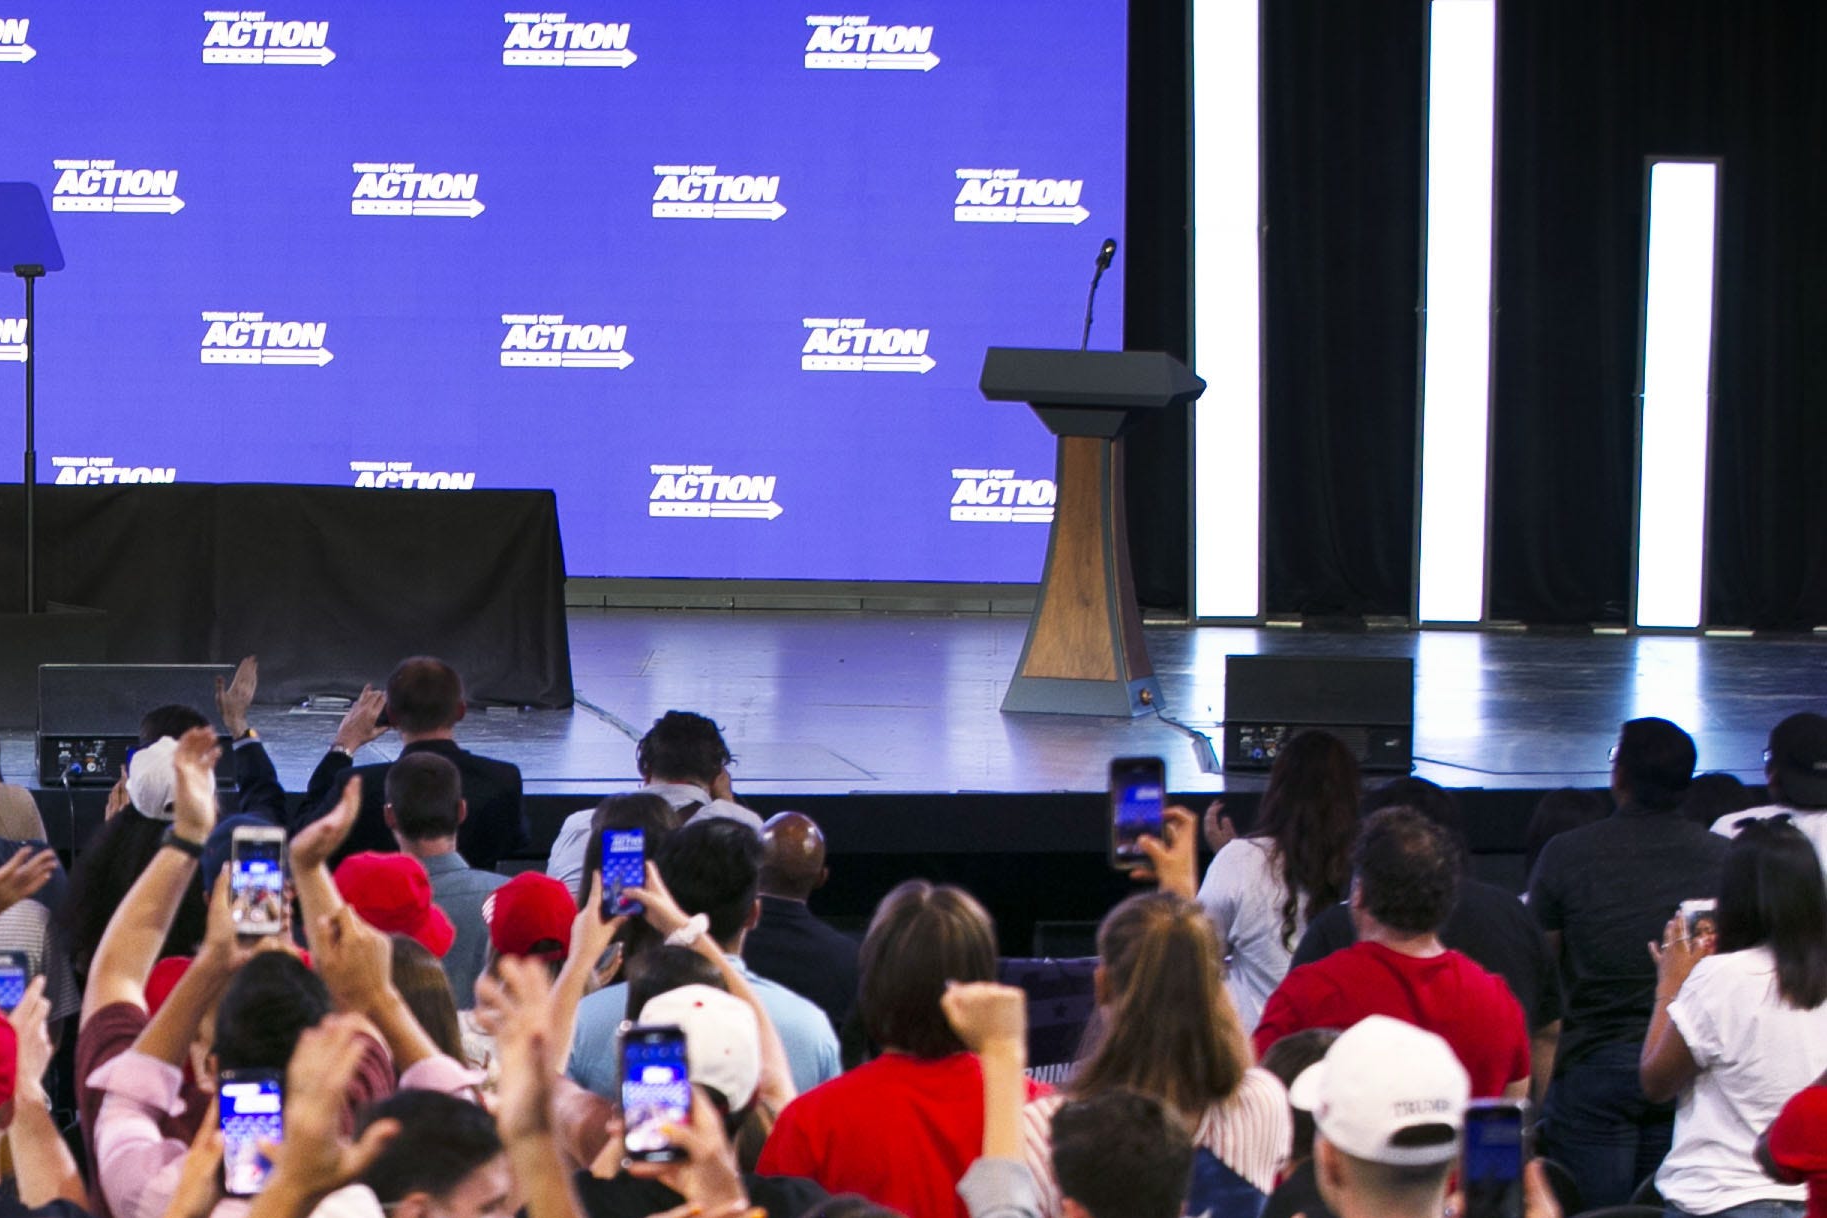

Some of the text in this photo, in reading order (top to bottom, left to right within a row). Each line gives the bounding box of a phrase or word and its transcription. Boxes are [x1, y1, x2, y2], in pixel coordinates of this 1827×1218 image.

[204, 21, 328, 47] ACTION
[504, 22, 629, 49] ACTION
[806, 25, 931, 52] ACTION
[54, 169, 178, 195] ACTION
[353, 172, 478, 198] ACTION
[654, 175, 779, 201] ACTION
[956, 178, 1081, 205] ACTION
[202, 321, 326, 347] ACTION
[502, 324, 626, 350] ACTION
[803, 328, 928, 354] ACTION
[650, 474, 776, 501] ACTION
[952, 479, 1056, 505] ACTIO
